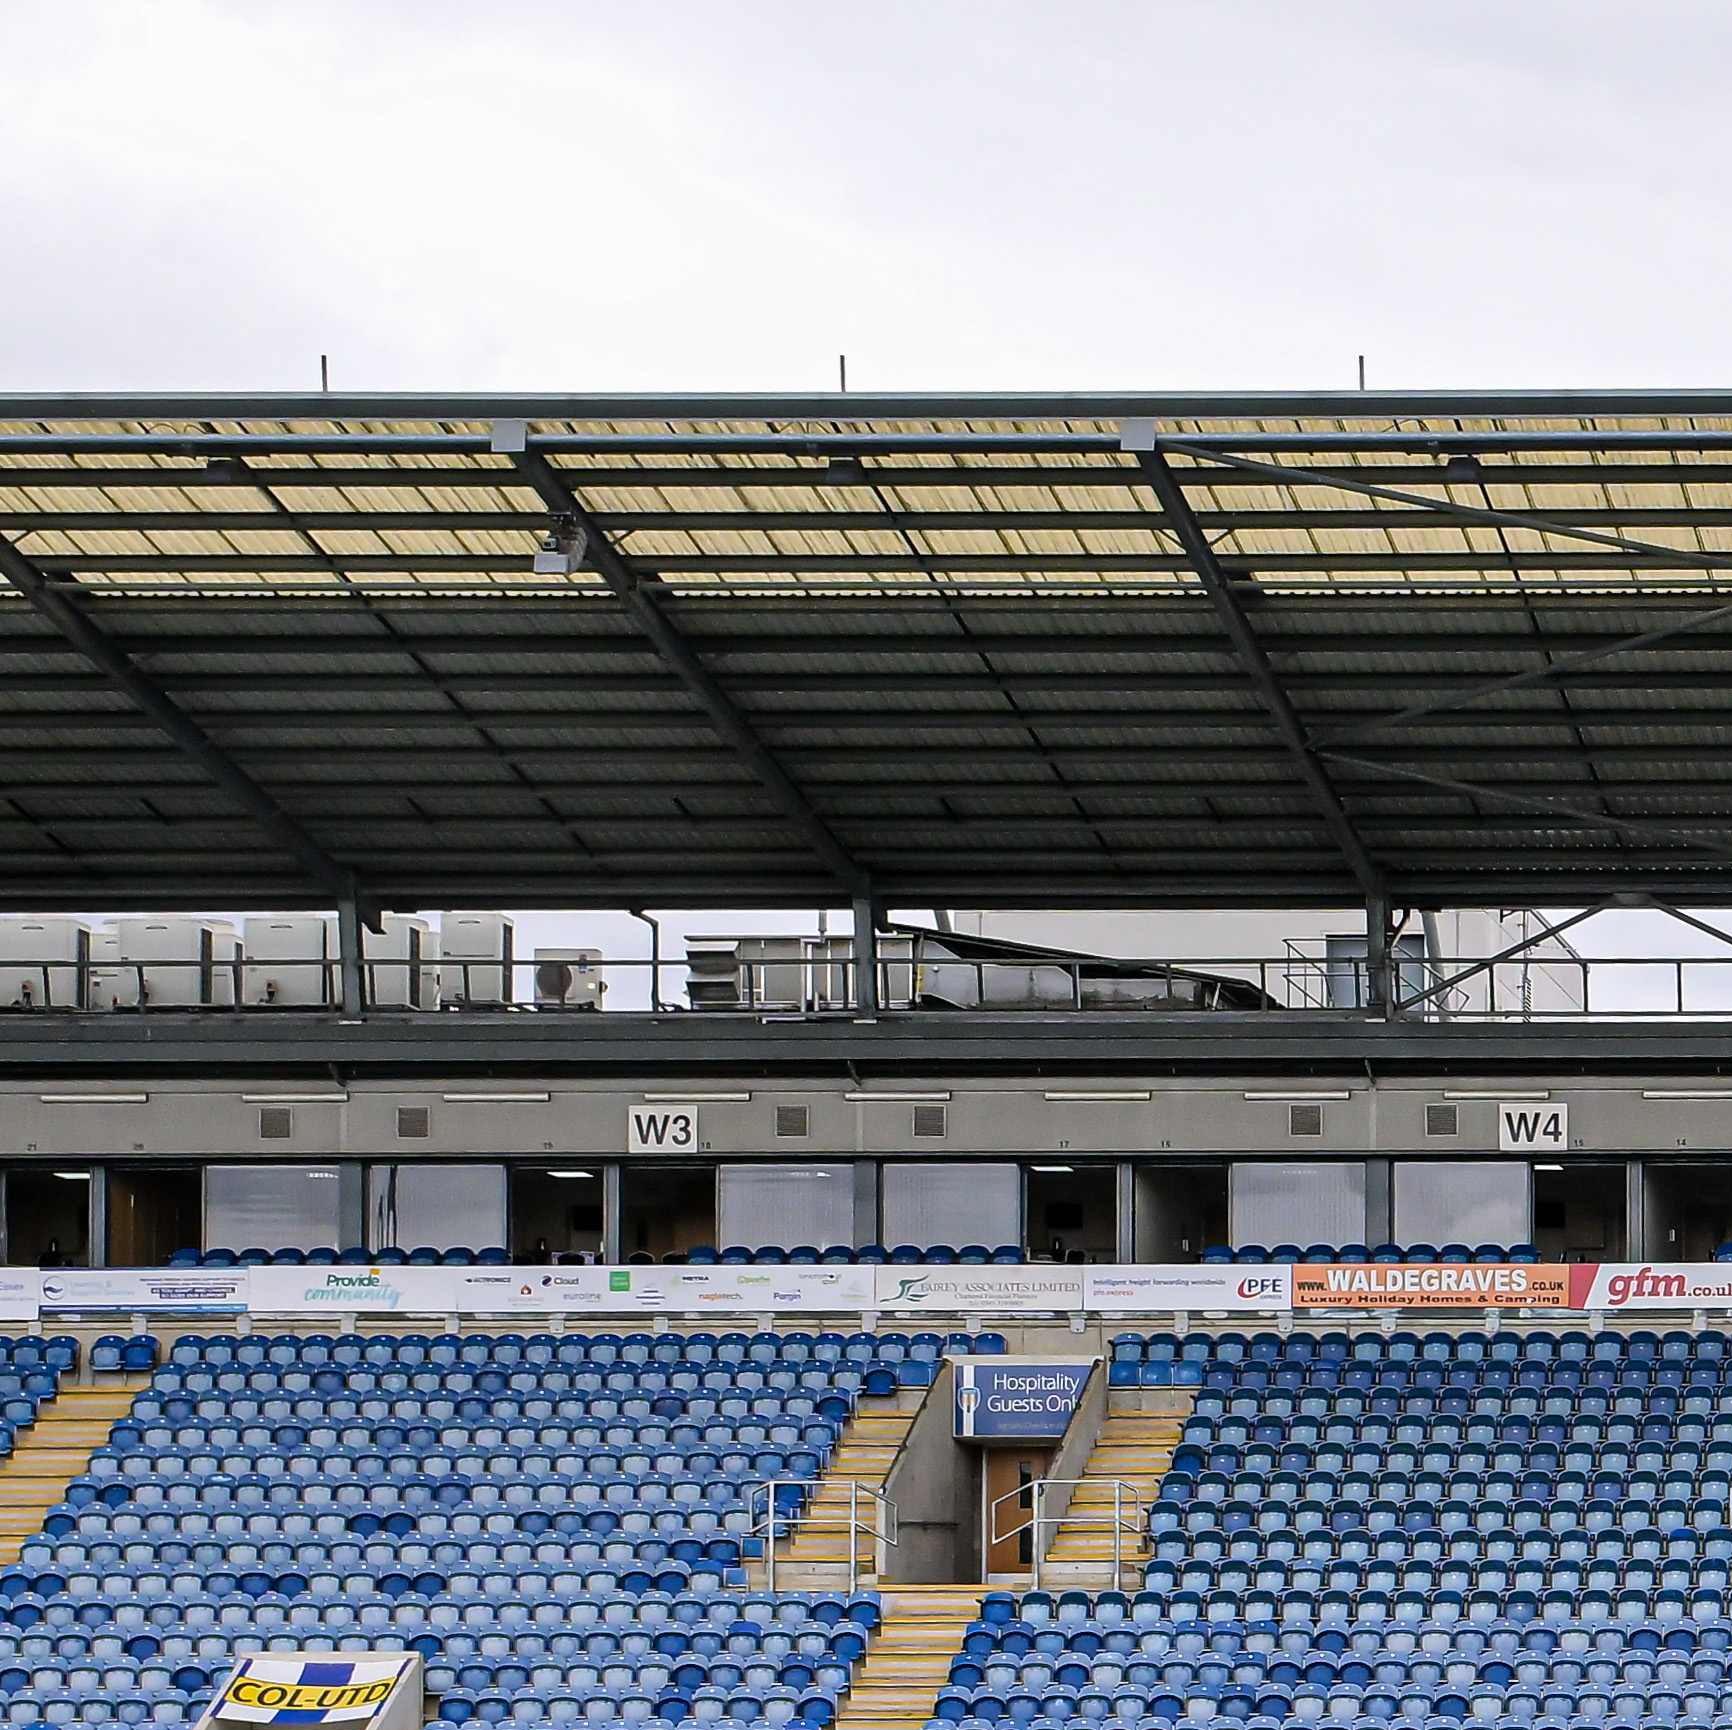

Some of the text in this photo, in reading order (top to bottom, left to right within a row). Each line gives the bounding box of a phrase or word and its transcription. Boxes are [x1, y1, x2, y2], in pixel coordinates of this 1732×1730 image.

[634, 1114, 692, 1146] W3
[1505, 1112, 1562, 1144] W4
[1059, 1140, 1069, 1148] 17
[326, 1273, 380, 1287] Provide
[554, 1277, 579, 1285] Cloud
[964, 1282, 1029, 1292] ASSOCIATES
[1031, 1282, 1081, 1292] LIMITED
[1247, 1279, 1283, 1293] PFE
[304, 1284, 403, 1309] community
[1300, 1295, 1353, 1305] Luxury
[1357, 1295, 1414, 1305] Holiday
[1420, 1295, 1472, 1304] Homes
[1477, 1295, 1488, 1304] &
[994, 1372, 1080, 1394] Hospitality
[987, 1395, 1043, 1412] Guests
[232, 1678, 390, 1708] COL-UTD
